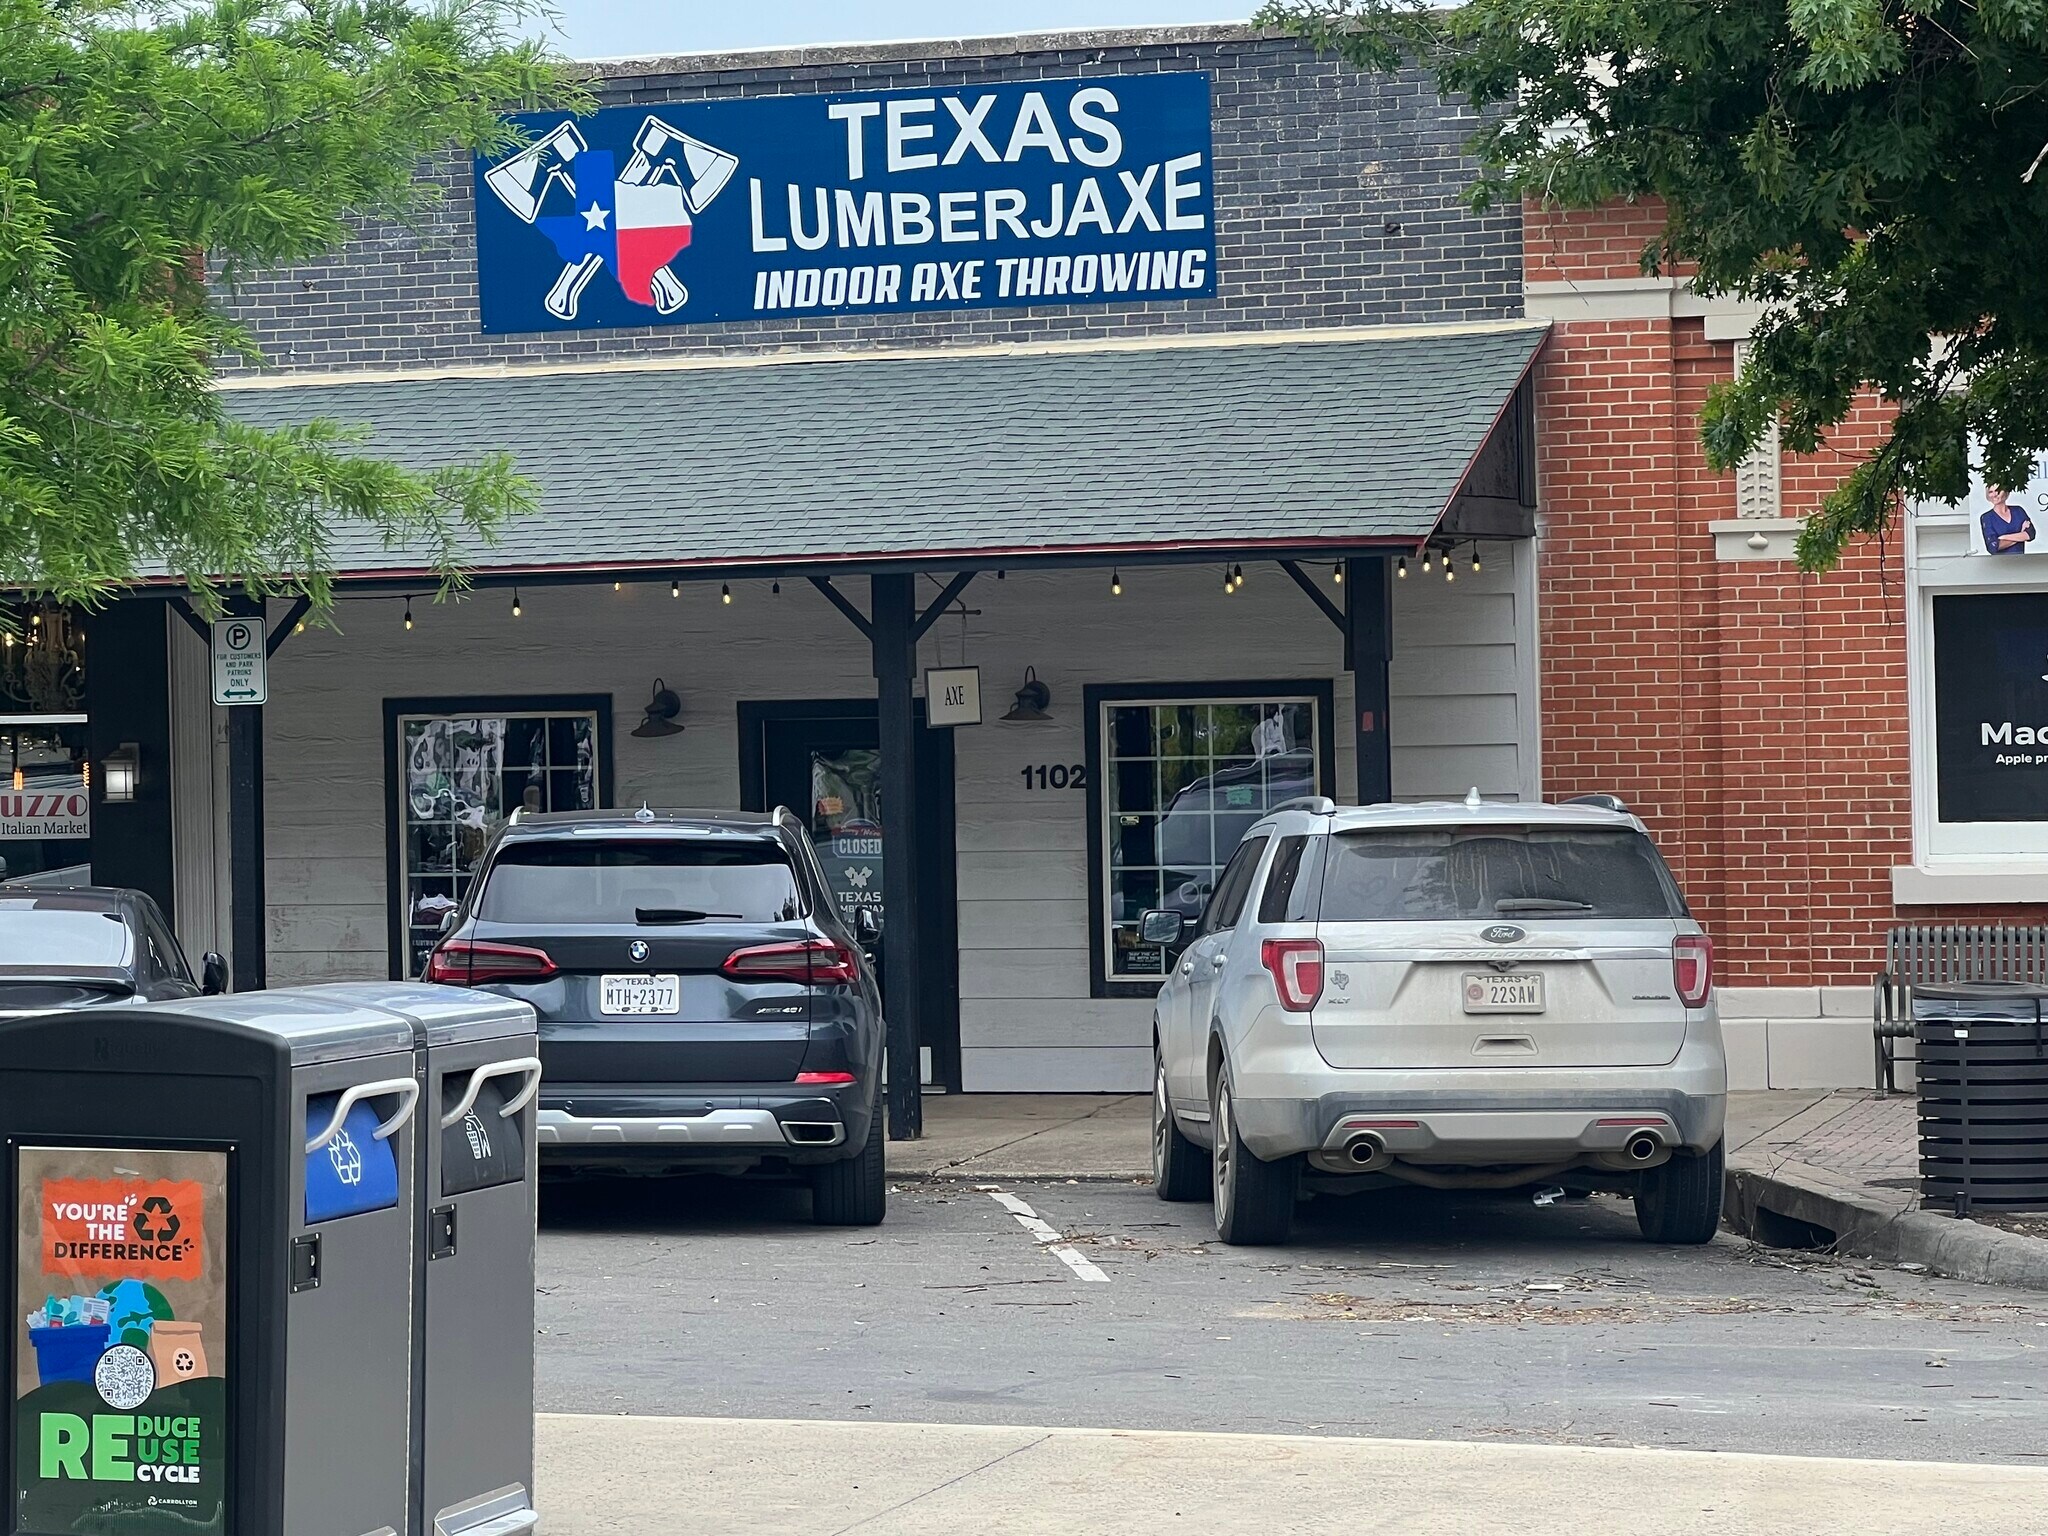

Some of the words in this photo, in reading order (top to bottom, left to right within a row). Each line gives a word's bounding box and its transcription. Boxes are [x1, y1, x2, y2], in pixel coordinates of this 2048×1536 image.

[828, 87, 1123, 181] TEXAS
[749, 152, 1205, 253] LUMBERJAXE
[753, 264, 902, 310] INDOOR
[910, 260, 985, 302] AXE
[995, 249, 1207, 298] THROWING
[229, 652, 262, 660] CUSTOMERS
[238, 660, 254, 668] PARK
[230, 678, 249, 688] ONLY
[944, 685, 965, 707] AXE
[1995, 753, 2033, 765] Apple
[1020, 764, 1087, 790] 1102
[1, 821, 41, 835] Italian
[43, 820, 88, 834] Market
[839, 838, 882, 854] CLOSED
[837, 891, 882, 903] TEXAS
[1490, 927, 1516, 939] Ford
[1441, 950, 1568, 960] EXPLORER
[625, 977, 655, 986] TEXAS
[1484, 975, 1522, 984] TEXAS
[52, 1202, 128, 1222] YOU'RE
[86, 1223, 125, 1241] THE
[54, 1242, 183, 1262] DIFFERENCE
[137, 1438, 200, 1465] USE
[136, 1465, 201, 1484] CYCLE
